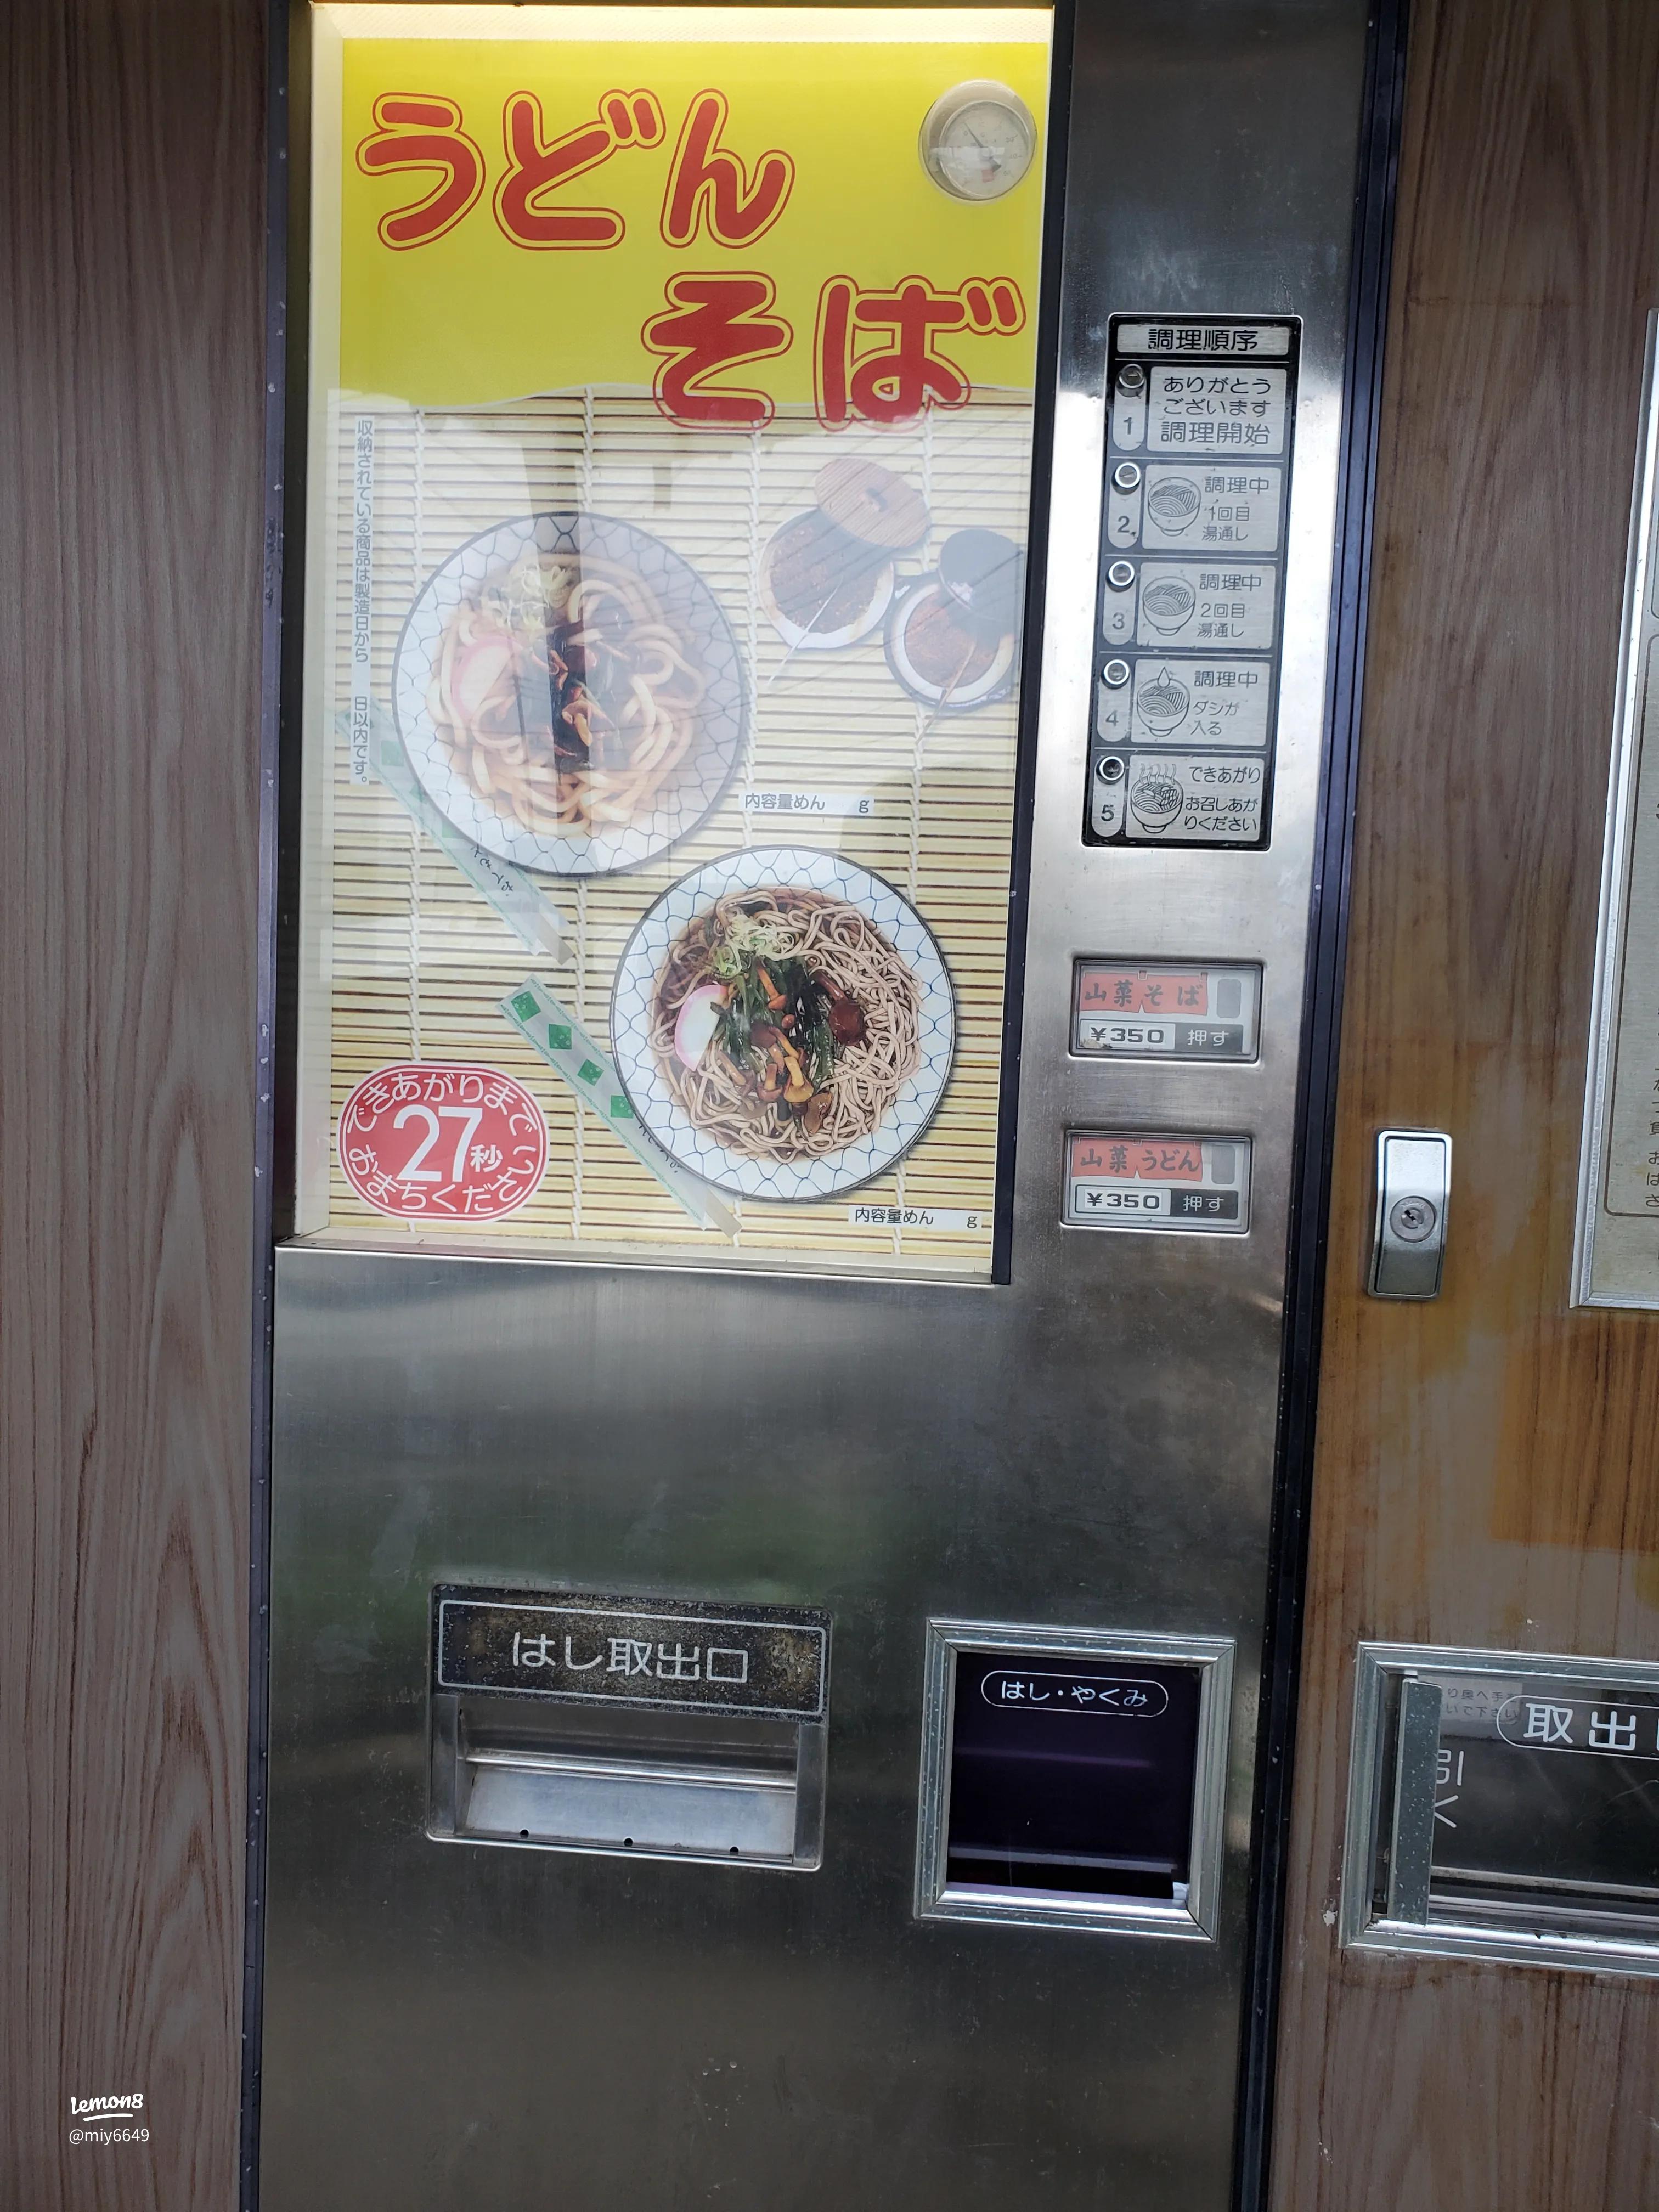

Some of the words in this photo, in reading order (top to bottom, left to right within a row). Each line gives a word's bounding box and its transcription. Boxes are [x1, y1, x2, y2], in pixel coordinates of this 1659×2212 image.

[356, 88, 795, 250] うどん
[1148, 329, 1259, 351] 調理順序
[641, 271, 1026, 432] そば
[1164, 376, 1271, 394] ありがとう
[1164, 398, 1271, 417] ございます
[1123, 417, 1132, 435] 1
[1161, 421, 1271, 445] 調理開始
[1205, 476, 1269, 494] 調理中
[1208, 506, 1250, 522] 1回目
[1118, 516, 1130, 533] 2
[1201, 526, 1248, 541] 湯通し
[1199, 574, 1261, 592] 調理中
[1200, 603, 1245, 619] 2回目
[1112, 613, 1125, 629] 3
[1197, 623, 1244, 639] 湯通し
[1194, 672, 1258, 689] 調理中
[1105, 710, 1119, 726] 4
[1190, 720, 1222, 736] 入る
[352, 696, 368, 782] 日以内です。
[1189, 766, 1261, 784] できあがり
[745, 793, 825, 810] 内容量めん
[859, 800, 869, 813] g
[1186, 797, 1258, 812] お召しあが
[1101, 805, 1114, 821] 5
[1184, 815, 1257, 831] りください
[1085, 979, 1203, 1007] 山菜そば
[1090, 1027, 1164, 1043] ¥350
[1188, 1029, 1229, 1046] 押す
[347, 1073, 539, 1136] できあがりまで
[1080, 1145, 1199, 1173] 山菜うどん
[349, 1145, 537, 1212] おまちください
[1086, 1192, 1160, 1209] ¥350
[1183, 1195, 1224, 1212] 押す
[855, 1207, 933, 1225] 内容量めん
[967, 1216, 977, 1228] g
[513, 1632, 748, 1684] はし取出口
[1002, 1680, 1148, 1707] はし・やくみ
[1523, 1703, 1659, 1751] 取出
